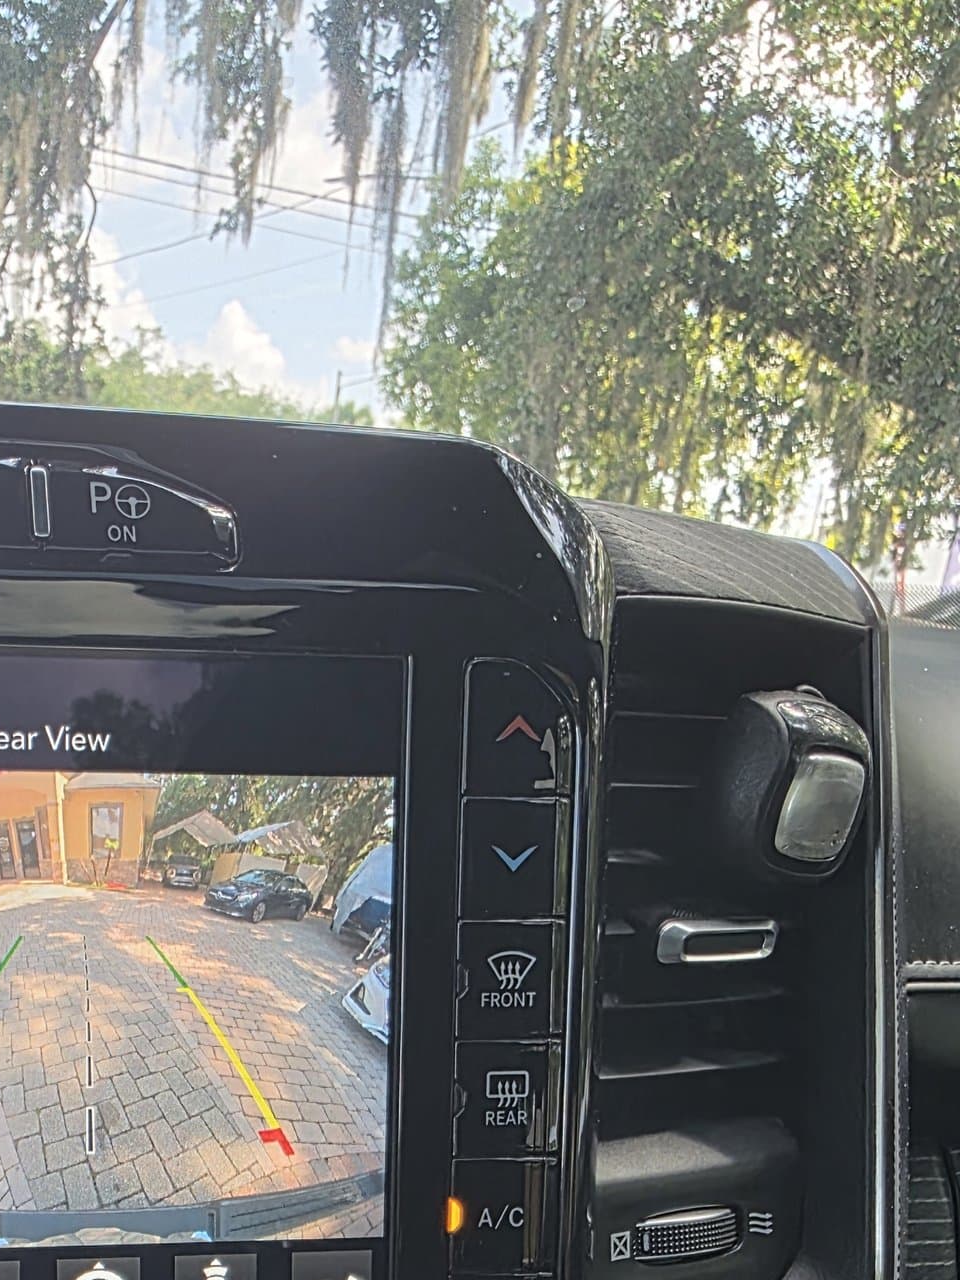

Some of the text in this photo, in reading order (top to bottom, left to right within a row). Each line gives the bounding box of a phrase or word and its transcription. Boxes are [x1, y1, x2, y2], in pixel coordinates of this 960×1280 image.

[106, 524, 138, 544] ON
[44, 725, 111, 752] View
[480, 991, 537, 1009] FRONT
[485, 1110, 528, 1126] REAR
[478, 1205, 525, 1228] A/C
